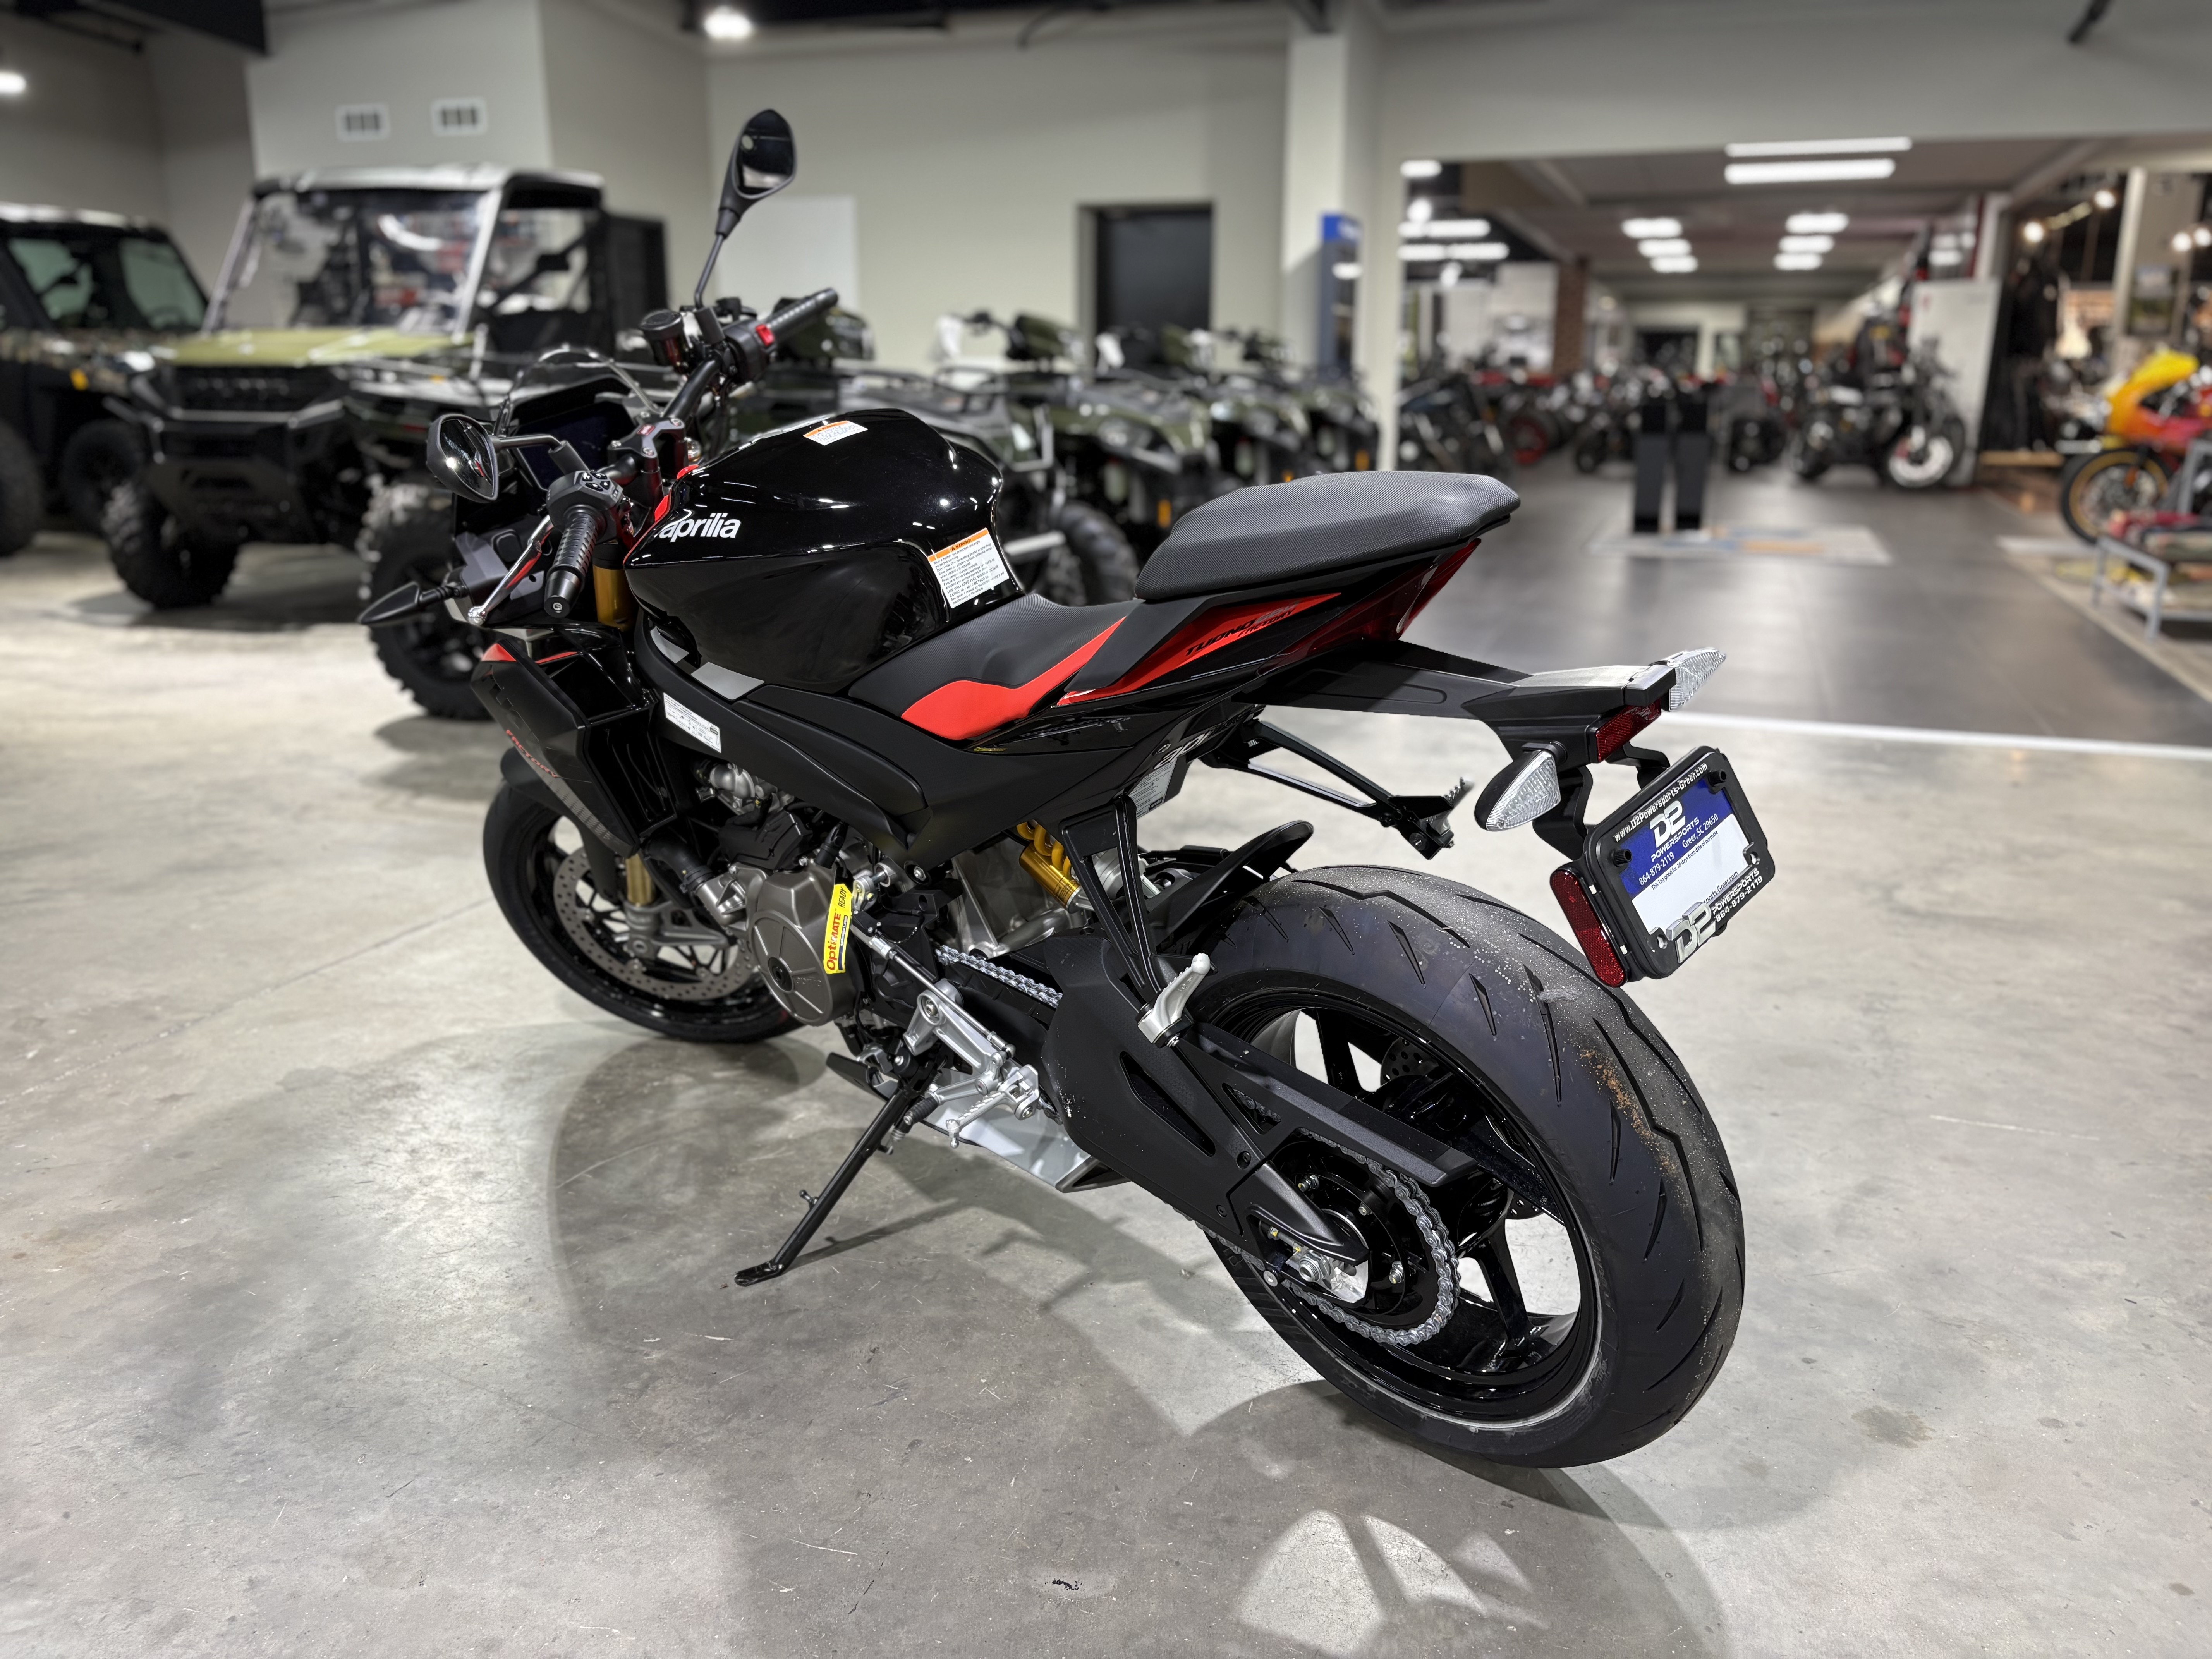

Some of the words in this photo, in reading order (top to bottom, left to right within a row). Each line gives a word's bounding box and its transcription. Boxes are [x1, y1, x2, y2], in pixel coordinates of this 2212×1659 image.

[659, 513, 741, 542] aprilia
[1185, 618, 1257, 656] TUONO
[1237, 608, 1296, 638] FACTORY
[1614, 763, 1708, 842] www.D2Powersports-Greer.com
[1650, 800, 1686, 848] D2
[1639, 852, 1674, 885] 864-879-2119
[1682, 833, 1698, 848] Greer,
[1696, 825, 1704, 836] SC
[1703, 813, 1718, 831] 29650
[1651, 817, 1699, 862] POWERSPORTS
[1664, 869, 1673, 881] good
[1688, 851, 1696, 860] from
[1705, 830, 1719, 845] purchase
[838, 887, 847, 908] READY
[1711, 867, 1759, 915] POWERSPORTS
[1715, 876, 1763, 922] 864-879-2119
[1666, 902, 1716, 963] D2
